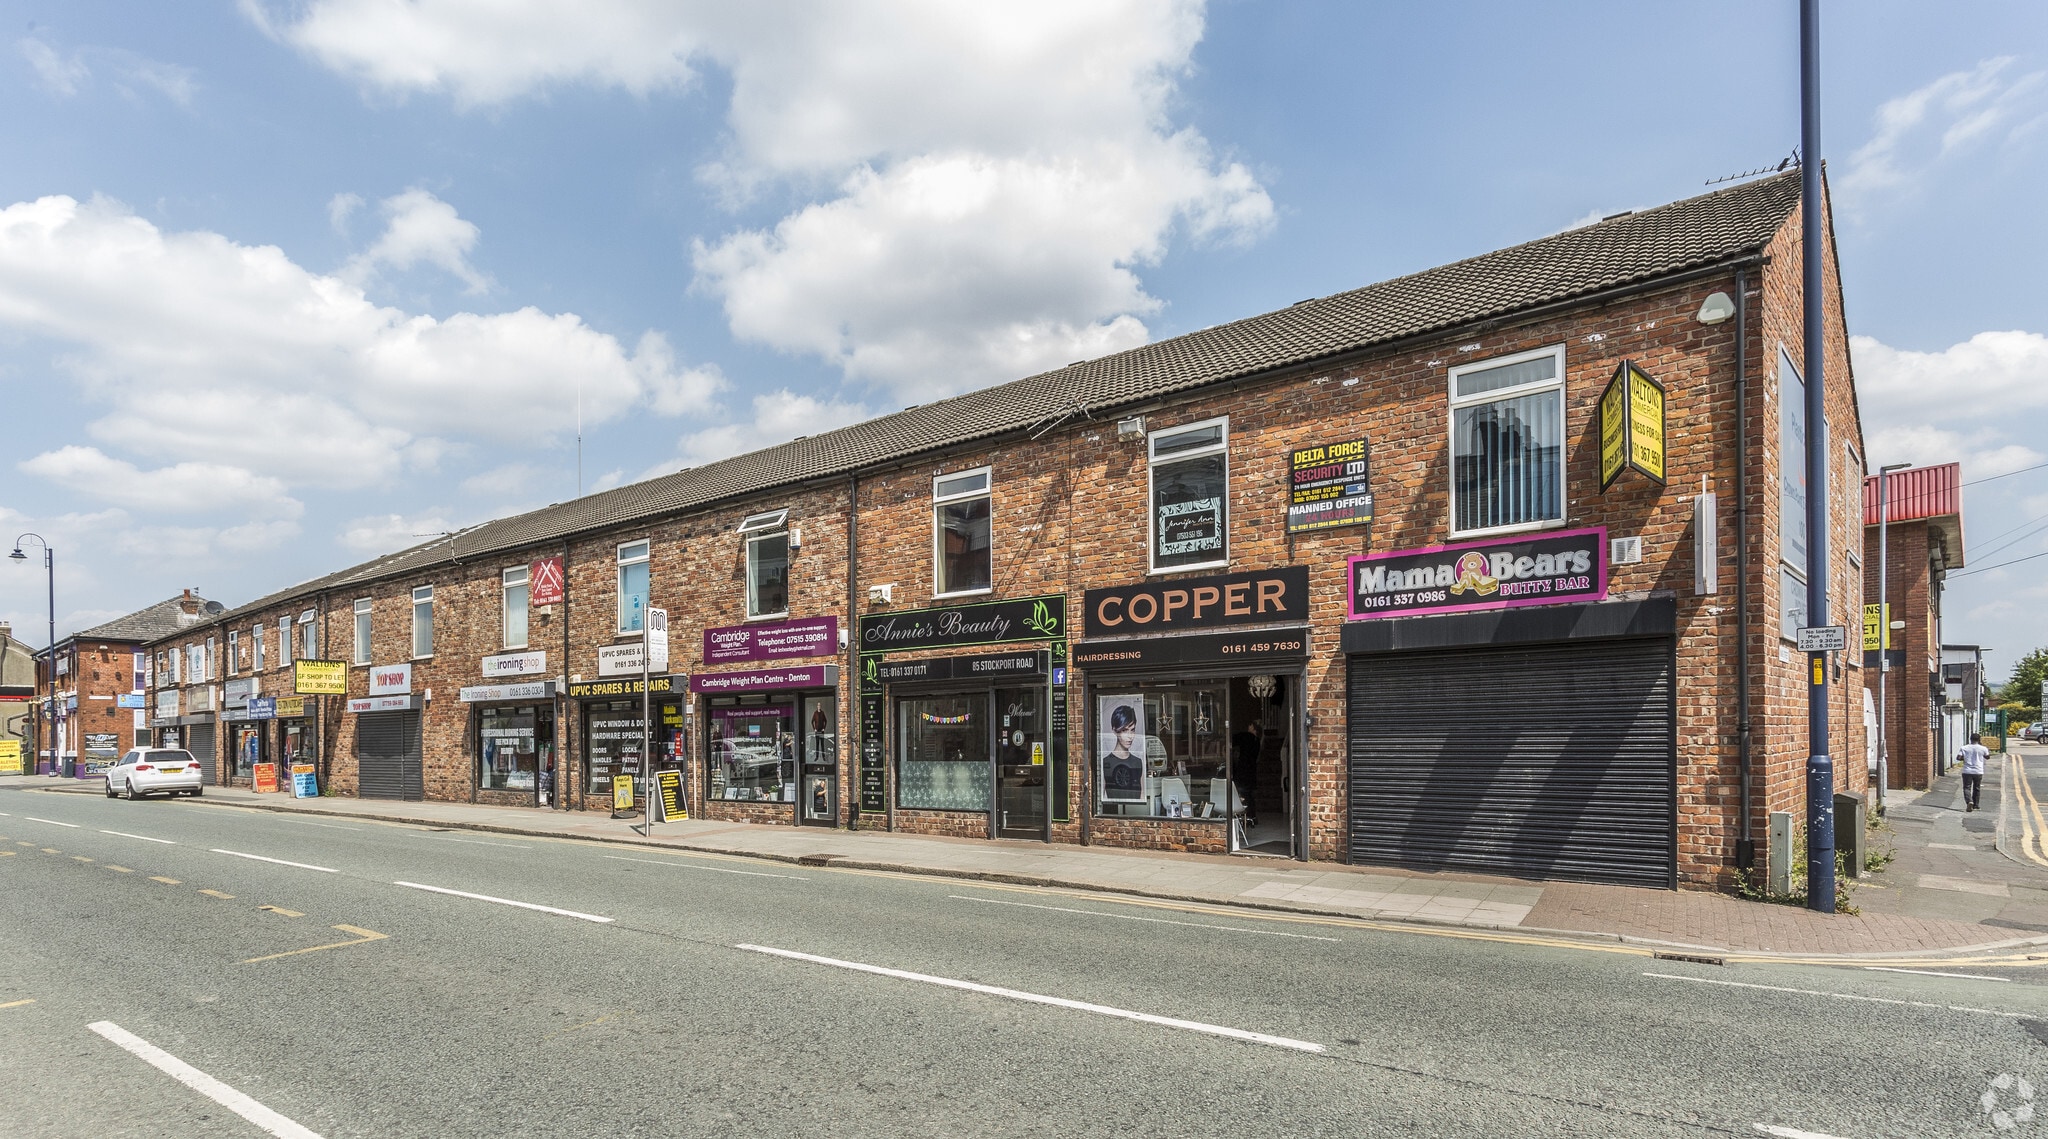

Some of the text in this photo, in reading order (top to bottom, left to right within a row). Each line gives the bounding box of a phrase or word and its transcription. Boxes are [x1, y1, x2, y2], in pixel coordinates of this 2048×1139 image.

[1632, 375, 1658, 409] WALTONS
[1646, 424, 1654, 438] FOR
[1294, 440, 1364, 464] DELTA FORCE
[1294, 461, 1364, 482] SECURITY LTD
[1290, 496, 1372, 515] MANNED OFFICE
[1306, 508, 1354, 522] 24 HOURS
[1166, 518, 1196, 532] Jennifer
[1358, 550, 1591, 595] Mama Bears
[1500, 576, 1590, 597] BUTTY BAR
[1098, 579, 1287, 626] COPPER
[1364, 591, 1446, 608] 0161 337 0986
[865, 612, 1010, 642] Annie's Beauty
[1864, 624, 1877, 635] ET
[711, 630, 750, 643] Cambridge
[758, 633, 828, 647] Telephone: 07515 390814
[1864, 637, 1880, 645] 950
[602, 650, 615, 658] UPVC
[1222, 642, 1300, 654] 0161 459 7630
[302, 660, 340, 668] WALTONS
[980, 659, 1014, 670] STOCKPORT
[1016, 658, 1034, 669] ROAD
[1077, 652, 1141, 662] HAIRDRESSING
[904, 666, 913, 676] 337
[914, 665, 926, 676] 0171
[702, 679, 730, 687] Cambridge
[731, 677, 750, 686] Weight
[750, 676, 764, 684] Plan
[764, 675, 784, 684] Centre
[789, 673, 810, 682] Denton
[462, 686, 544, 700] The Ironing Shop 0161 336 0304
[570, 684, 590, 696] UPVC
[592, 682, 622, 696] SPARES
[624, 682, 632, 693] &
[664, 706, 676, 714] Mobile
[1008, 702, 1036, 717] Welcome
[592, 720, 606, 728] UPVC
[608, 720, 630, 728] WINDOW
[636, 720, 652, 728] DOR
[664, 716, 683, 724] Locksmith
[519, 728, 534, 736] SERVICE
[592, 732, 653, 740] HARDWARE SPECIALT
[622, 766, 639, 774] PANELS
